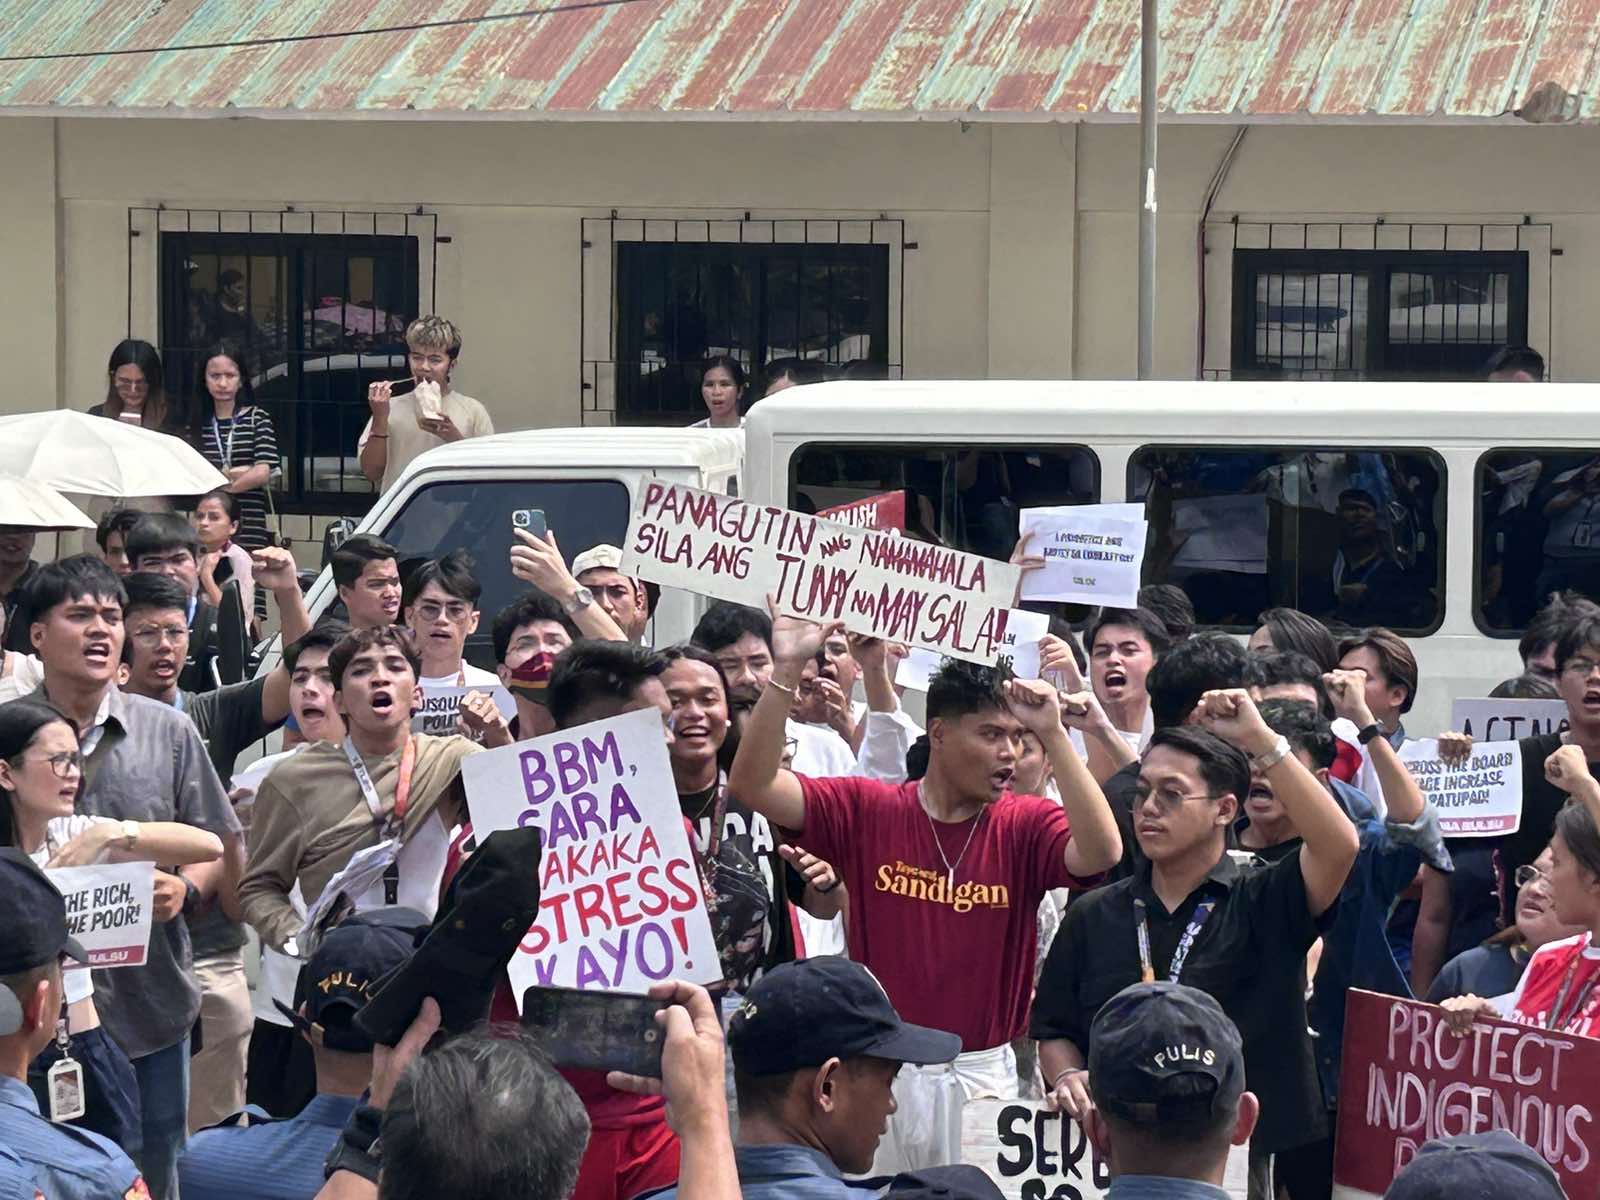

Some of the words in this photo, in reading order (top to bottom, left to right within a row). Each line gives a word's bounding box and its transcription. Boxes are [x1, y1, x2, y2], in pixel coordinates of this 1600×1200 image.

[643, 484, 816, 555] PANAGUTIN
[634, 523, 692, 568] SILA
[697, 542, 753, 580] ANG
[921, 594, 1009, 657] SALA!
[519, 731, 638, 805] BBM,
[517, 783, 642, 849] SARA
[542, 825, 661, 890] AKAKA
[66, 913, 88, 935] HE
[90, 903, 141, 932] POOR!
[92, 882, 134, 909] RICH,
[1153, 1044, 1215, 1068] PULIS
[1388, 1002, 1575, 1091] PROTECT
[1366, 1062, 1593, 1173] INDIGENOUS
